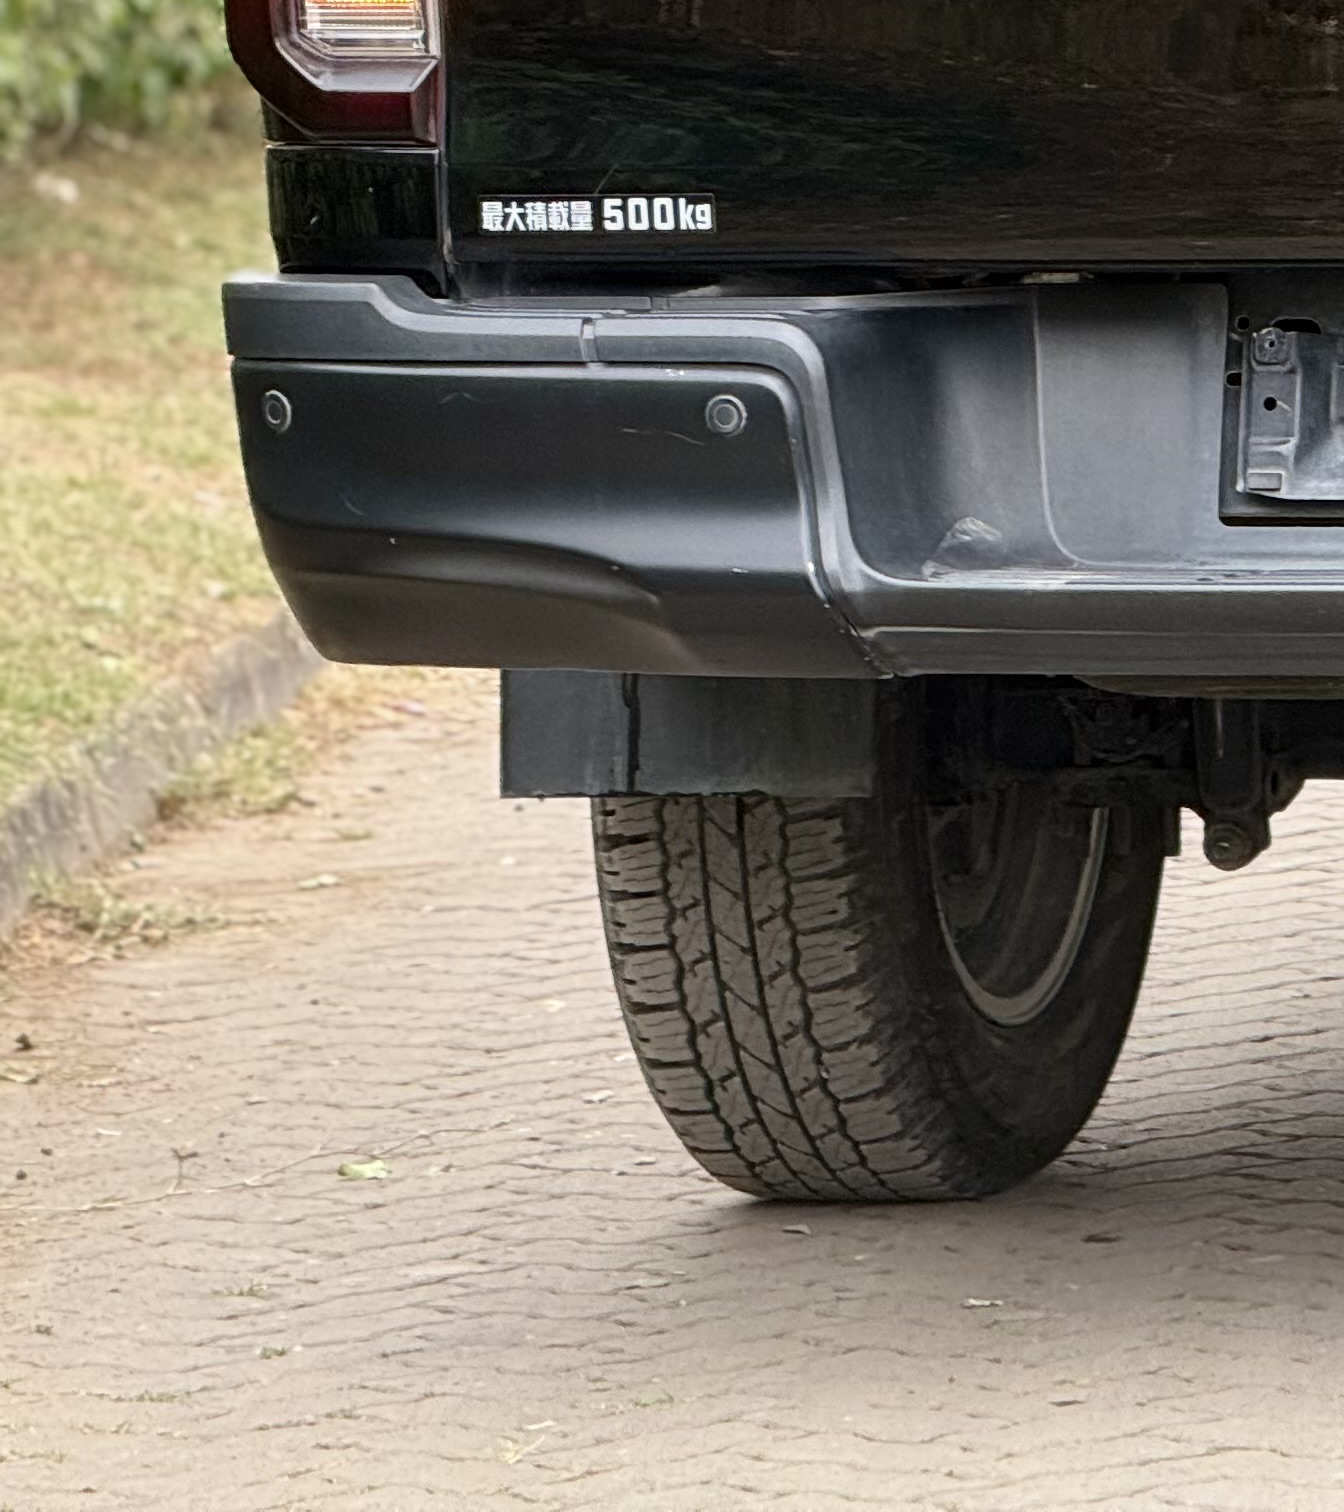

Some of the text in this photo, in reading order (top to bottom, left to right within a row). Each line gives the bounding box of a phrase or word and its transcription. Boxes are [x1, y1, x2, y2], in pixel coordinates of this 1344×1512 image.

[480, 196, 714, 232] 最大積載量 500kg
